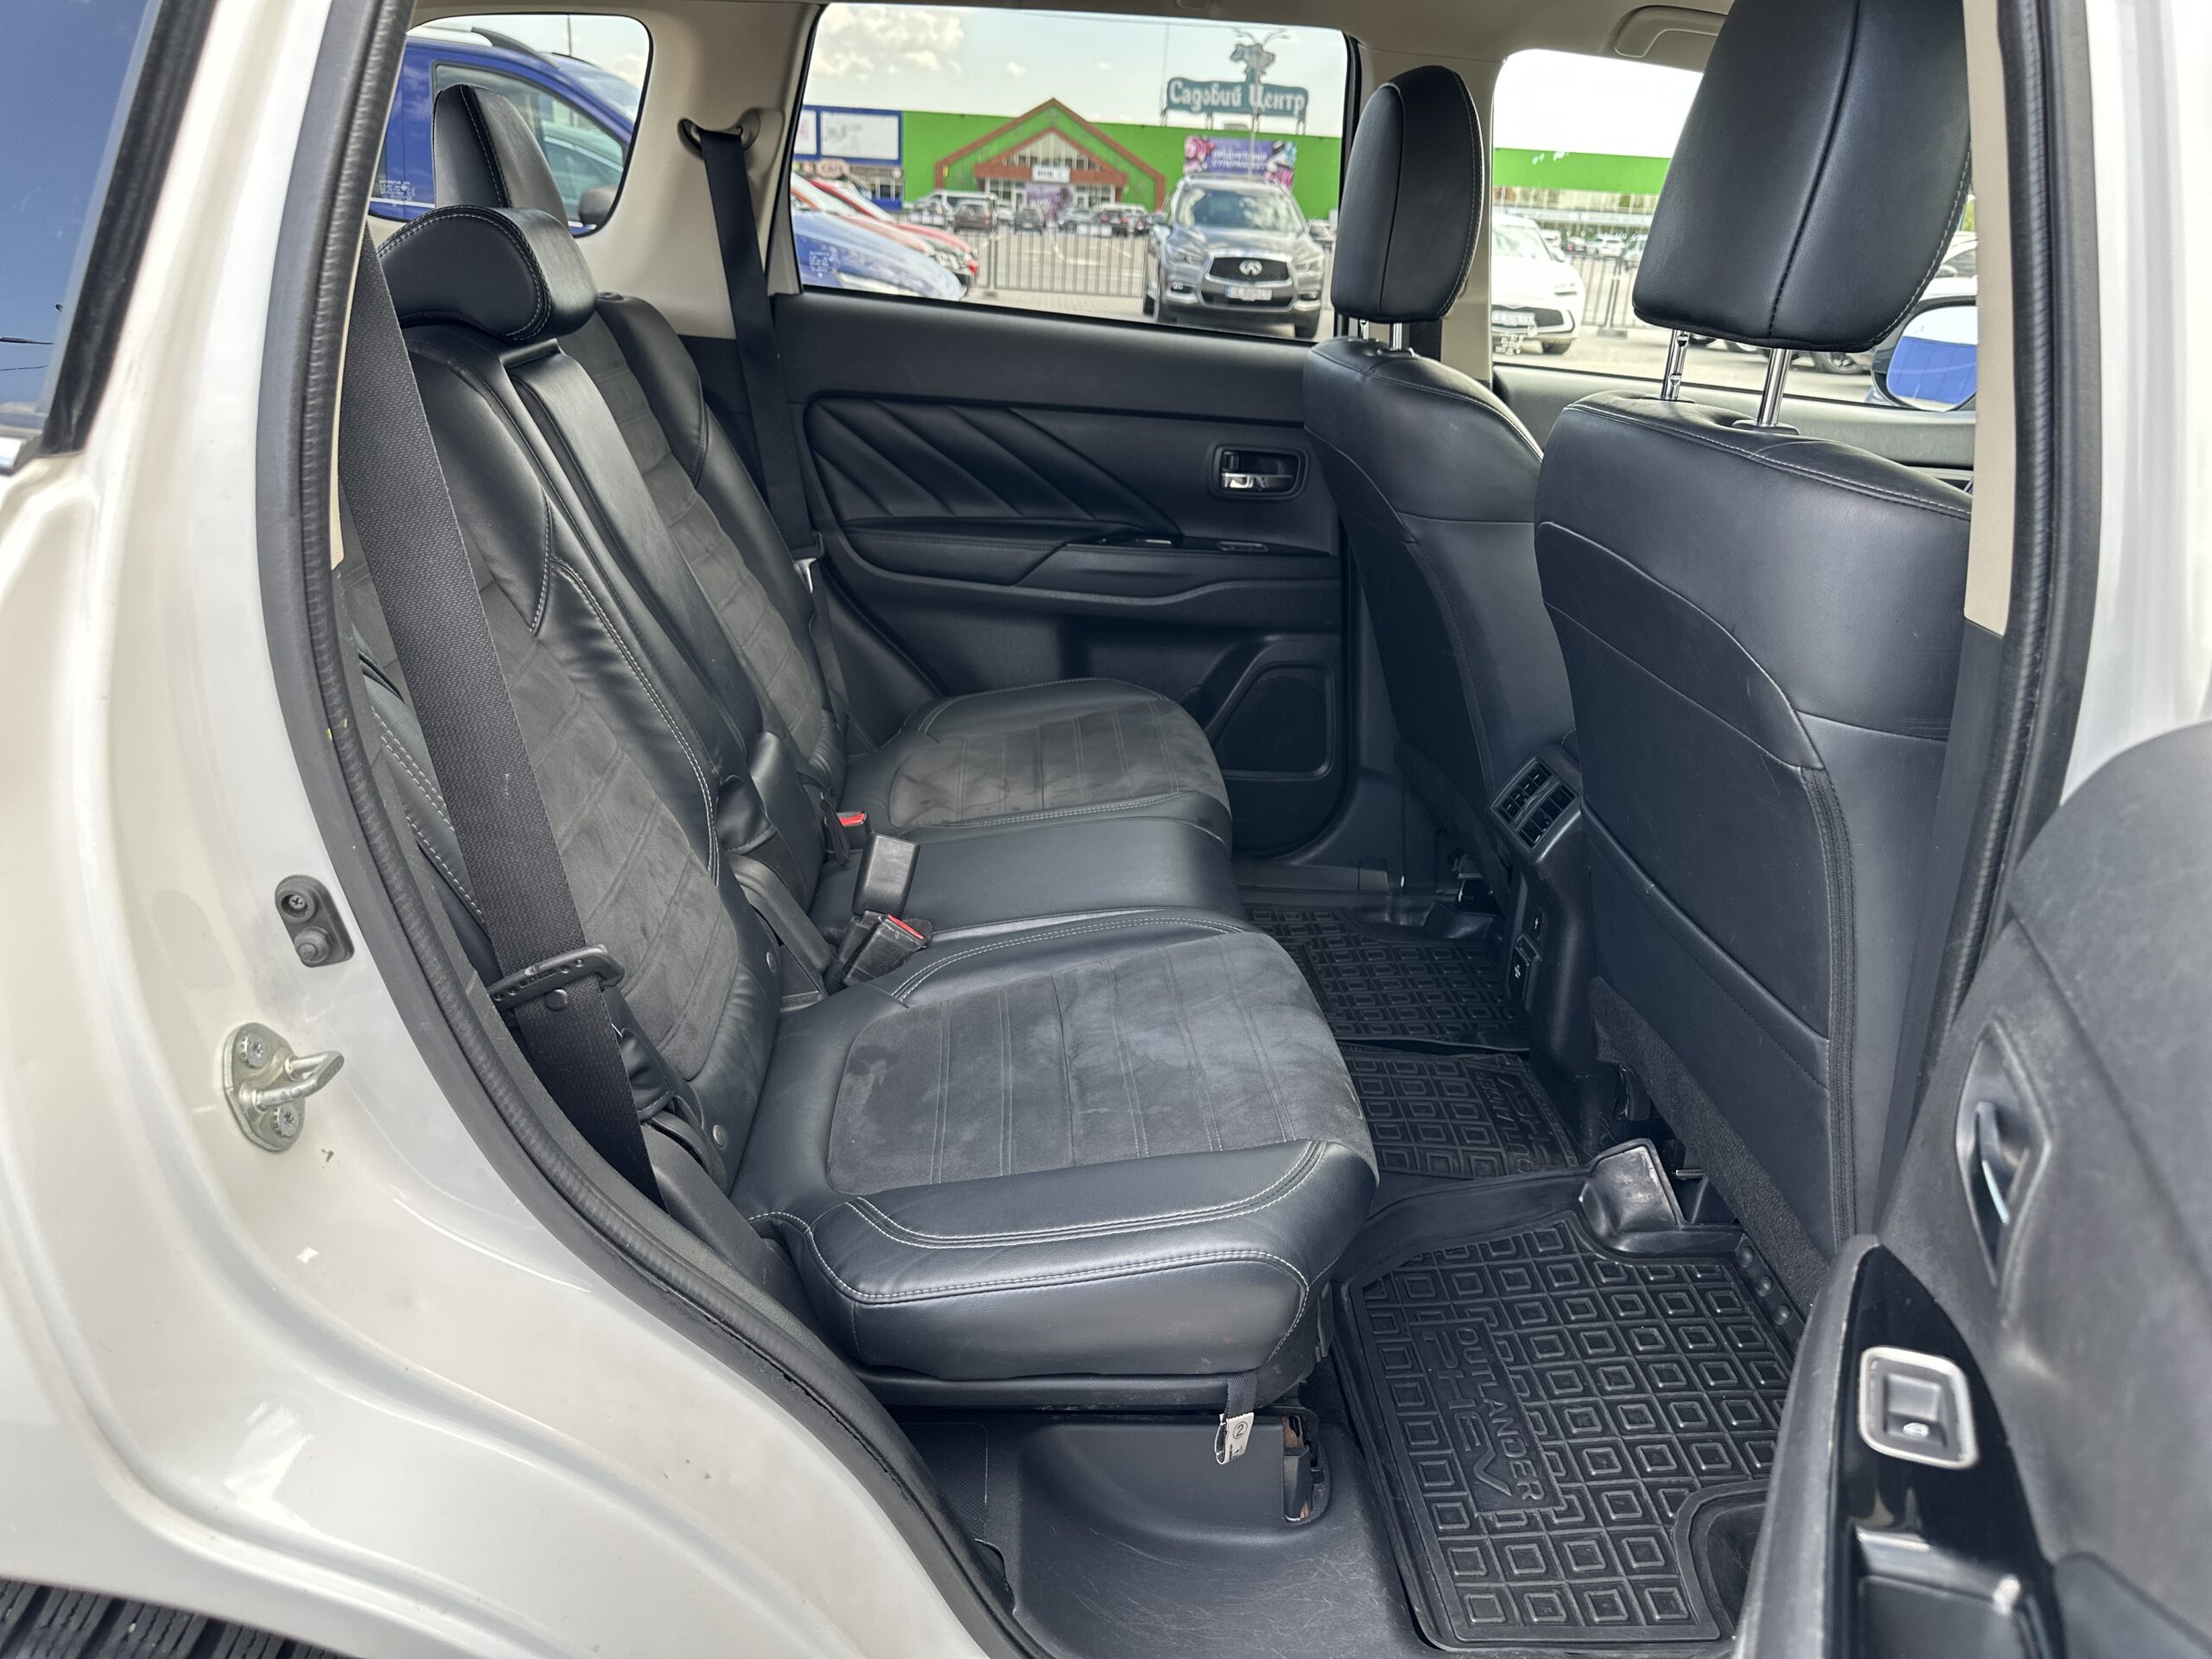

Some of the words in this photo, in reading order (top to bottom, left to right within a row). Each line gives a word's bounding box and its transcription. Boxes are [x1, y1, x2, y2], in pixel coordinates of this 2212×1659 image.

[1169, 79, 1243, 112] Садовий
[1249, 83, 1306, 117] Центр
[1422, 1331, 1512, 1497] PHEV
[1455, 1327, 1545, 1501] OUTLANDER
